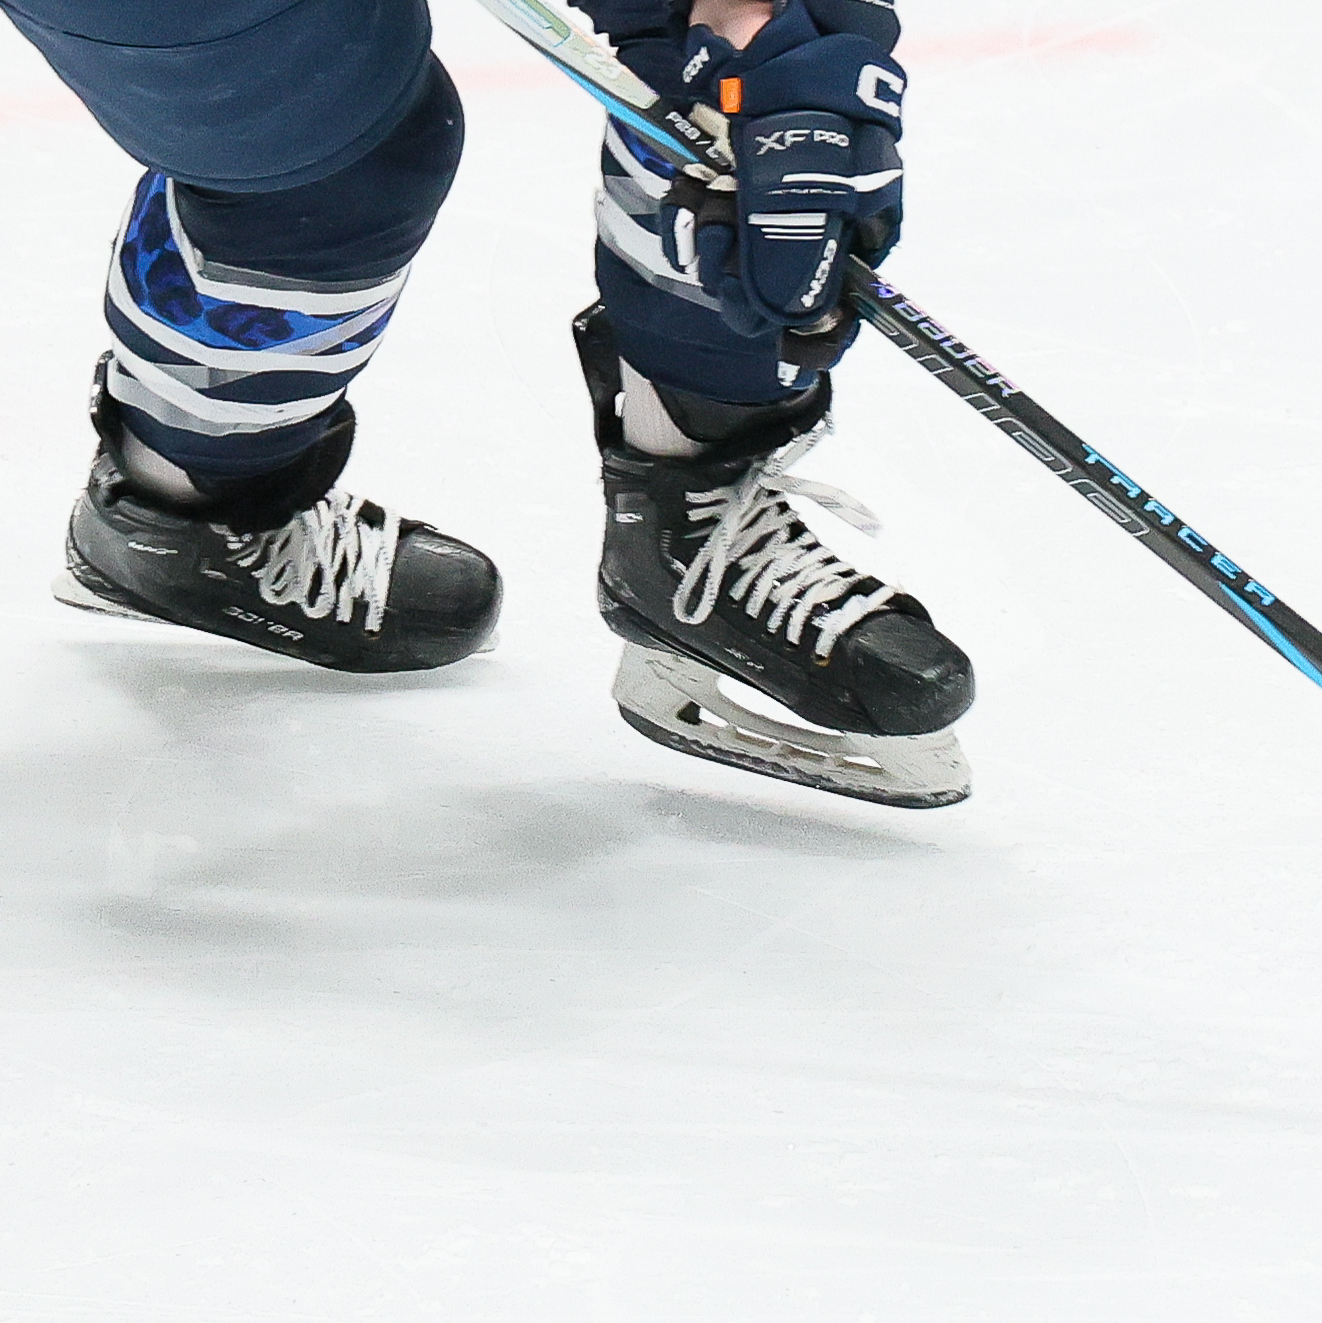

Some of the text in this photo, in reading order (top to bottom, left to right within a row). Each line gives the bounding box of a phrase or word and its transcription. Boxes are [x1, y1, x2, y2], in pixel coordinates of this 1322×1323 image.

[755, 129, 850, 156] XF PRO
[891, 295, 1022, 398] BAUER
[1081, 441, 1276, 608] TRACER
